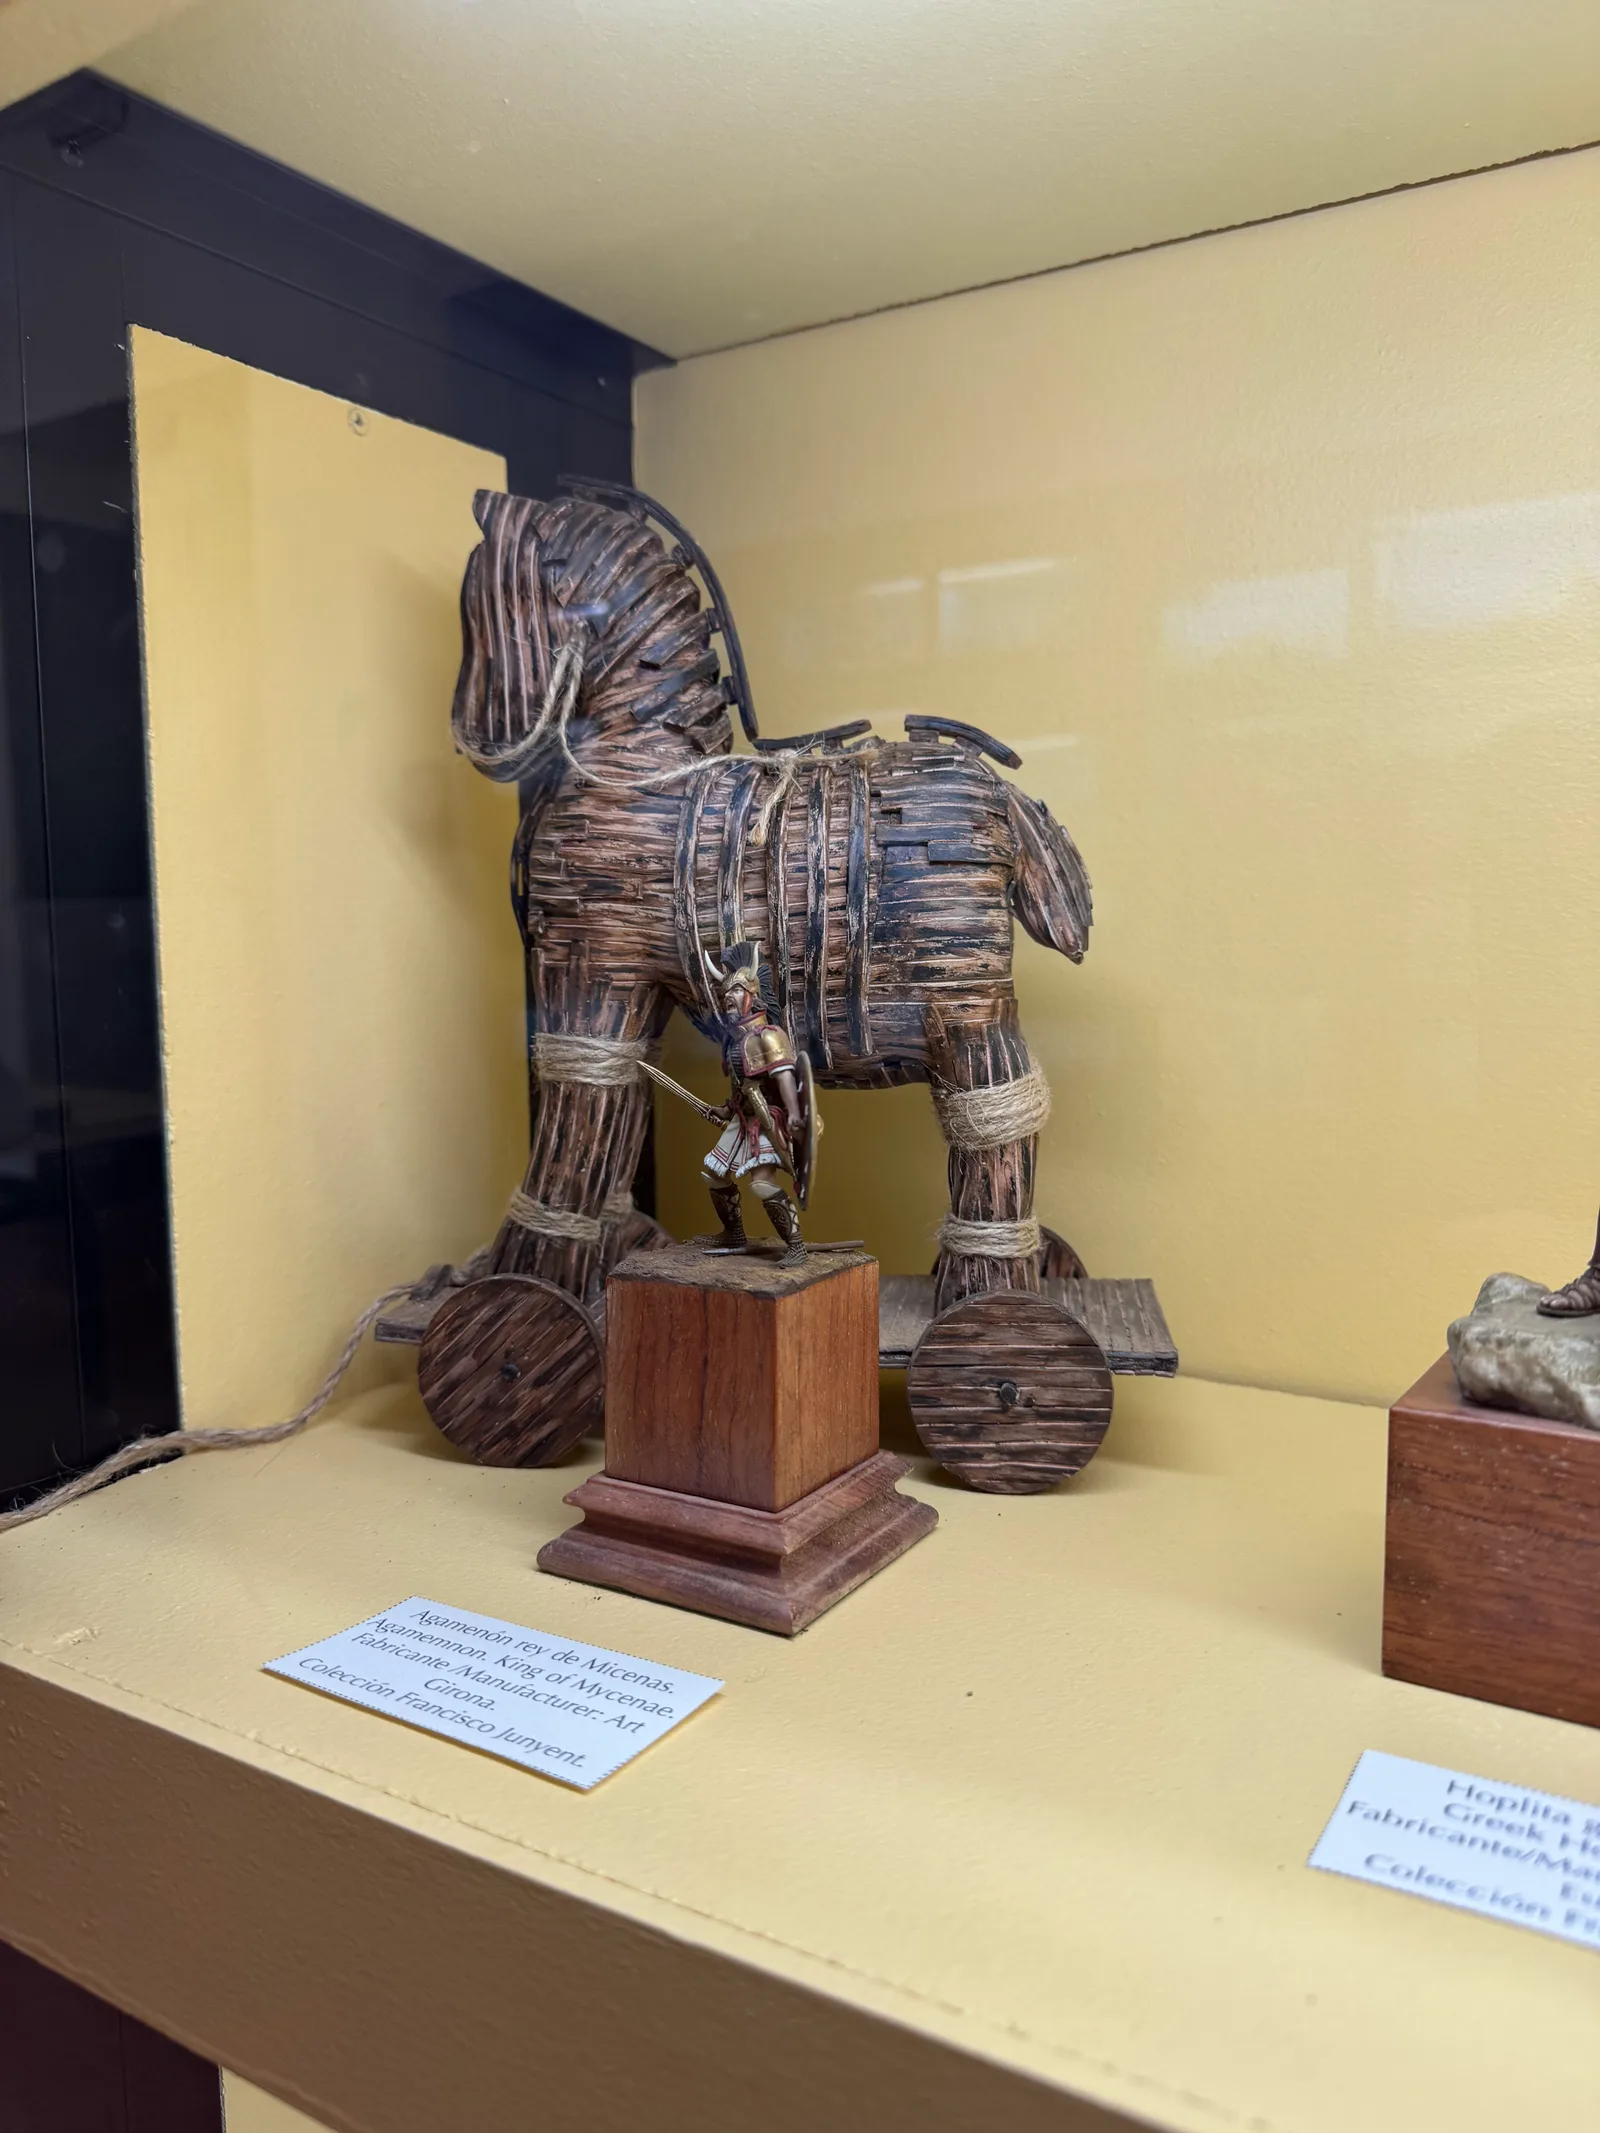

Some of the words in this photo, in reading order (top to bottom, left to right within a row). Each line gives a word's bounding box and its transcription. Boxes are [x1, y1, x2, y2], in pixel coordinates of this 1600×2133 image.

[351, 1633, 450, 1670] Fabricante
[450, 1664, 603, 1720] /Manufacturer:
[603, 1716, 646, 1734] Art
[368, 1617, 487, 1660] Agamemnon.
[494, 1654, 544, 1679] King
[546, 1663, 573, 1685] of
[570, 1678, 675, 1719] Mycenae.
[410, 1609, 512, 1643] Agamenón
[515, 1640, 550, 1659] rey
[551, 1647, 580, 1665] de
[582, 1657, 675, 1694] Micenas.
[300, 1658, 395, 1697] Colección
[396, 1692, 495, 1733] Francisco
[494, 1728, 585, 1768] Junyent.
[424, 1678, 496, 1711] Girona.
[1443, 1803, 1546, 1841] Greek
[1447, 1780, 1571, 1825] Hoplita
